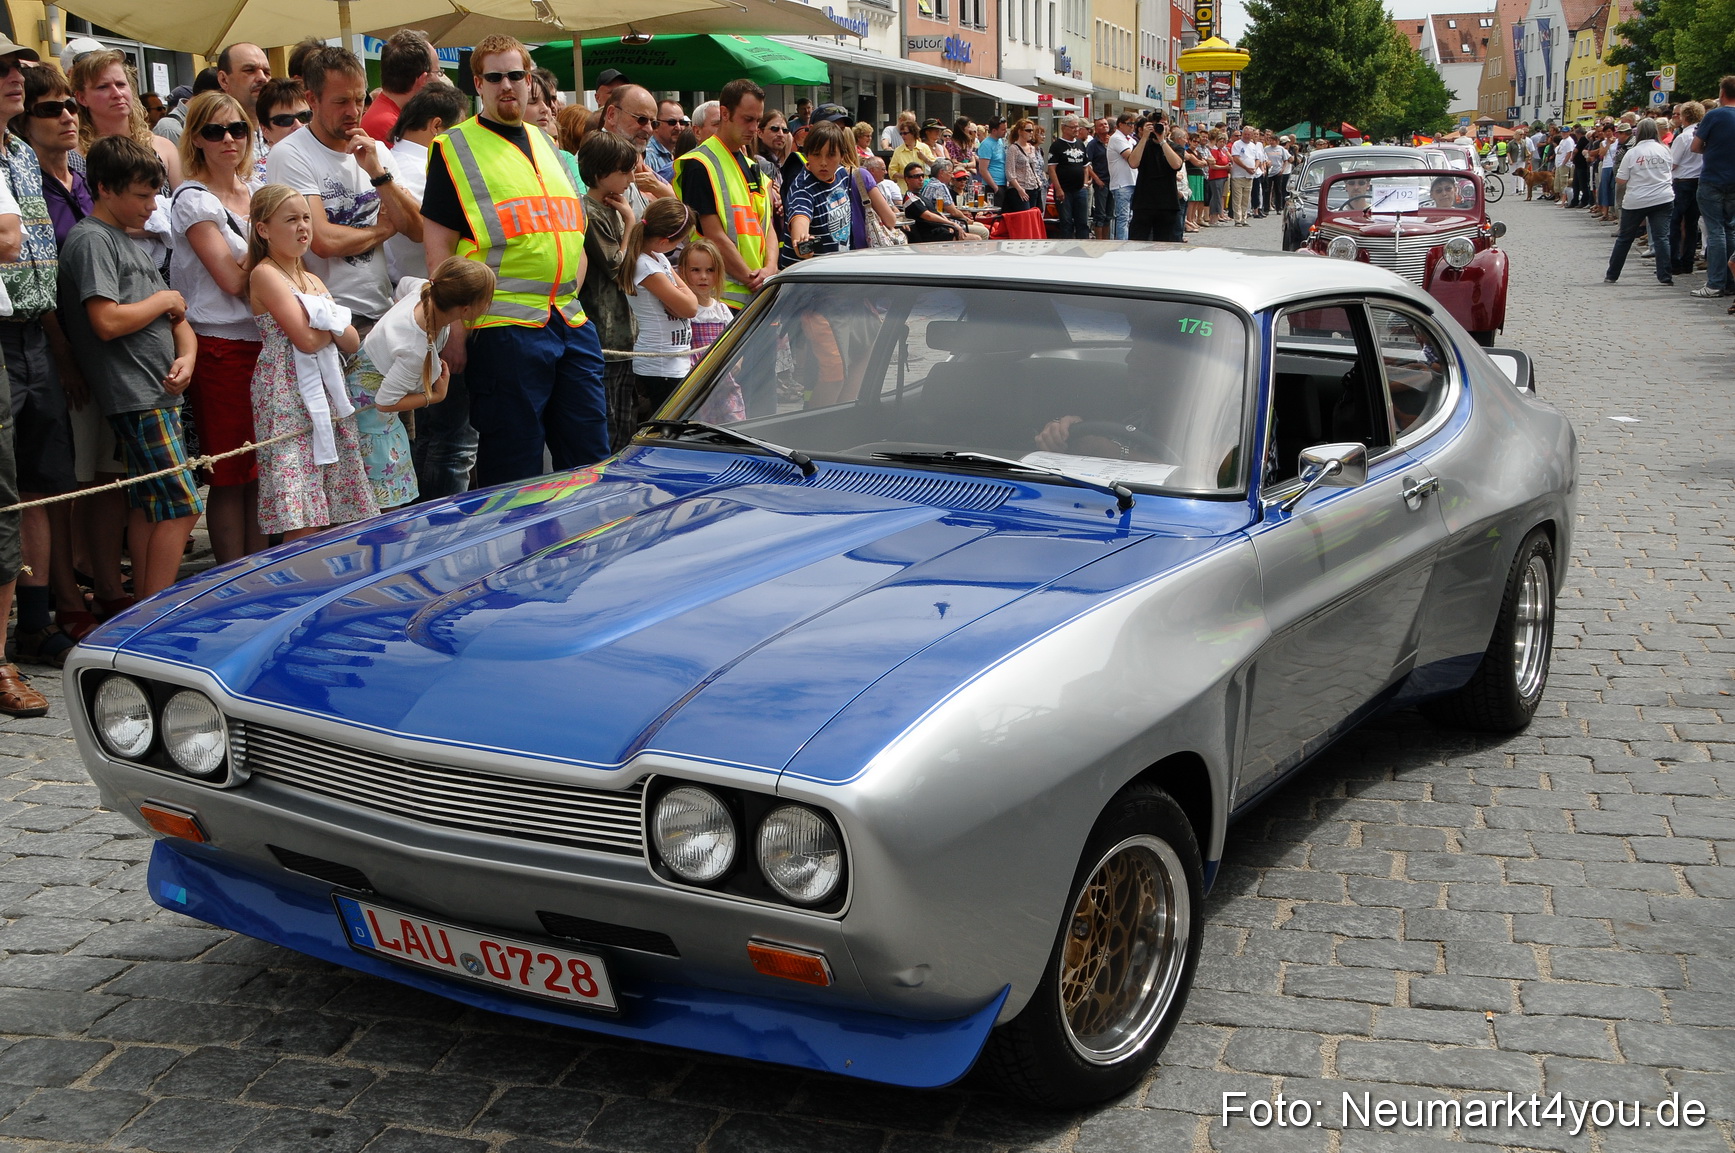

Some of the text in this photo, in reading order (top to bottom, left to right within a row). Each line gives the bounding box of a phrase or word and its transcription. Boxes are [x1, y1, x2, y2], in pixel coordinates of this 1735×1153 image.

[590, 48, 669, 57] Neumarkter
[571, 55, 677, 67] ammsbräu
[1396, 190, 1413, 200] 192
[498, 197, 578, 234] THW
[1178, 317, 1214, 337] 175
[366, 909, 600, 998] LAU 0728
